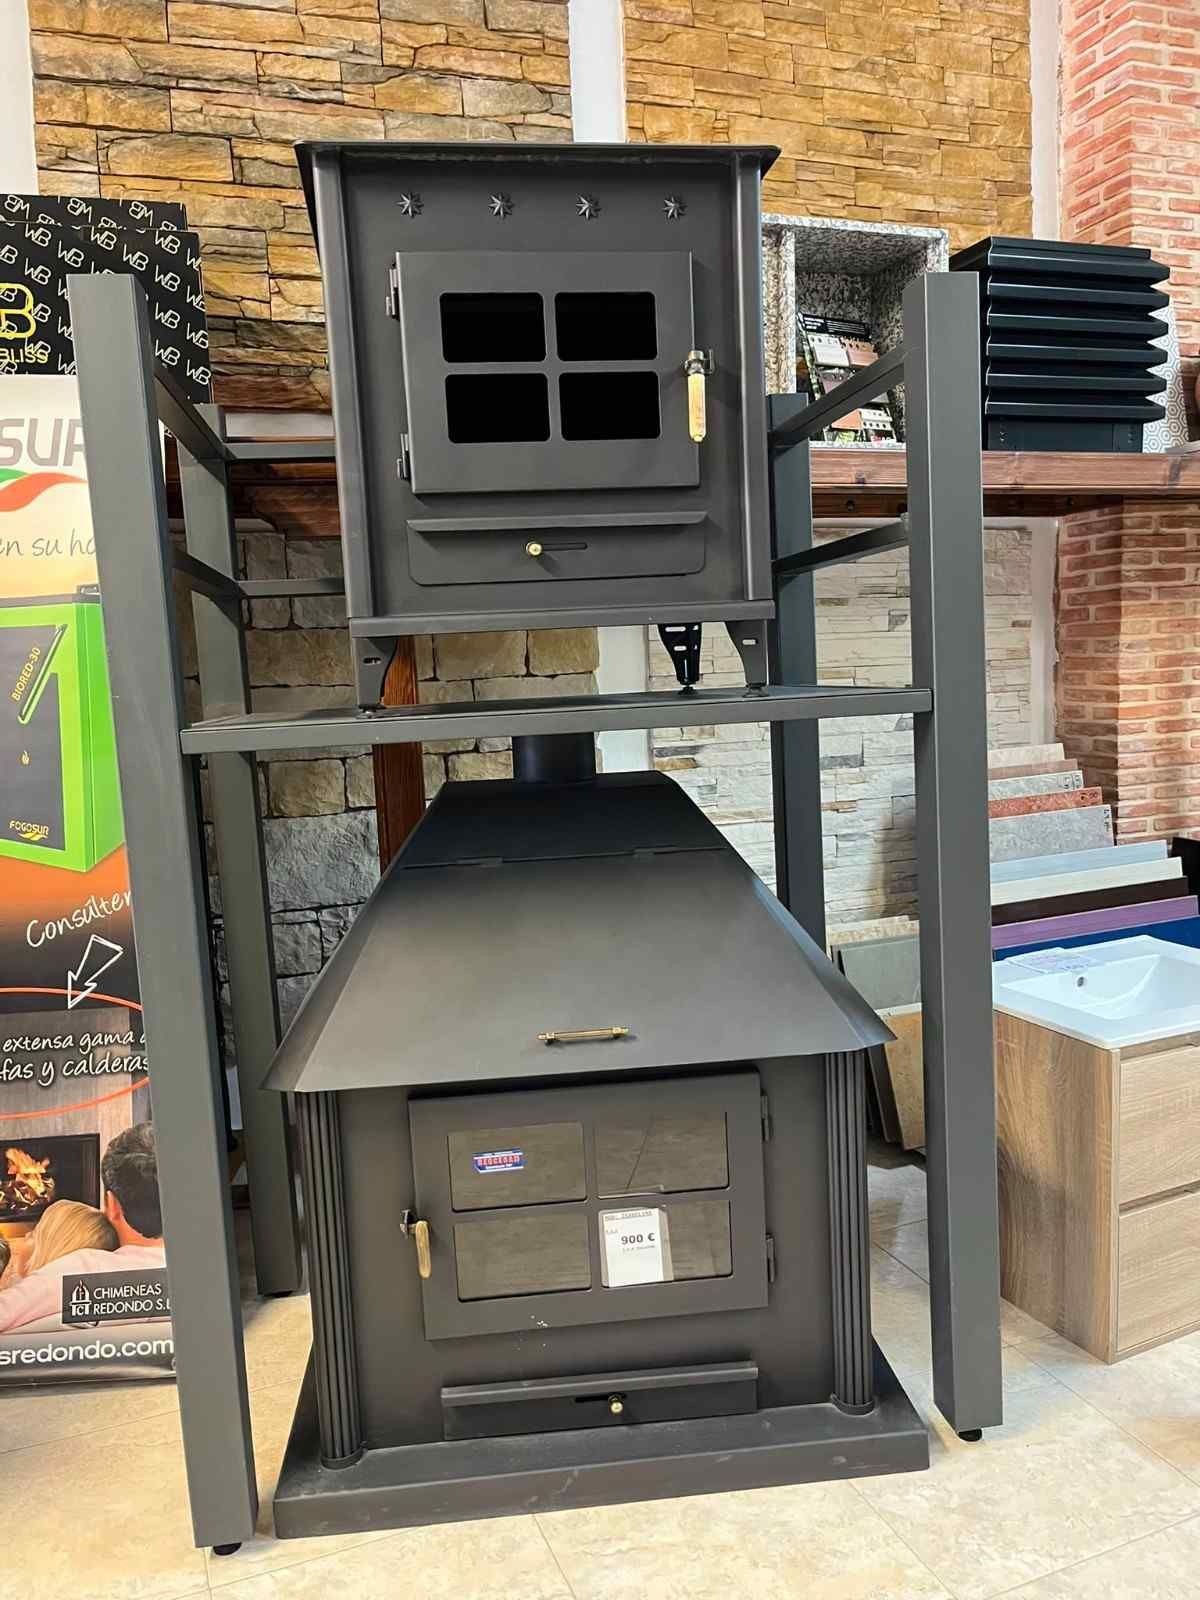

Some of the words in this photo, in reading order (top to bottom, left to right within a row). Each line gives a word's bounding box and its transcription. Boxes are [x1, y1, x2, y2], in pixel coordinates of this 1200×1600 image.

[32, 537, 63, 557] su
[11, 647, 41, 701] BIORED-30
[9, 820, 49, 836] FOGOSUR
[2, 1034, 74, 1052] extensa
[80, 1031, 134, 1054] gama
[38, 1060, 55, 1086] y
[620, 1233, 644, 1246] 900
[647, 1231, 656, 1242] €
[93, 1283, 162, 1300] CHIMENEAS
[93, 1299, 154, 1315] REDONDO
